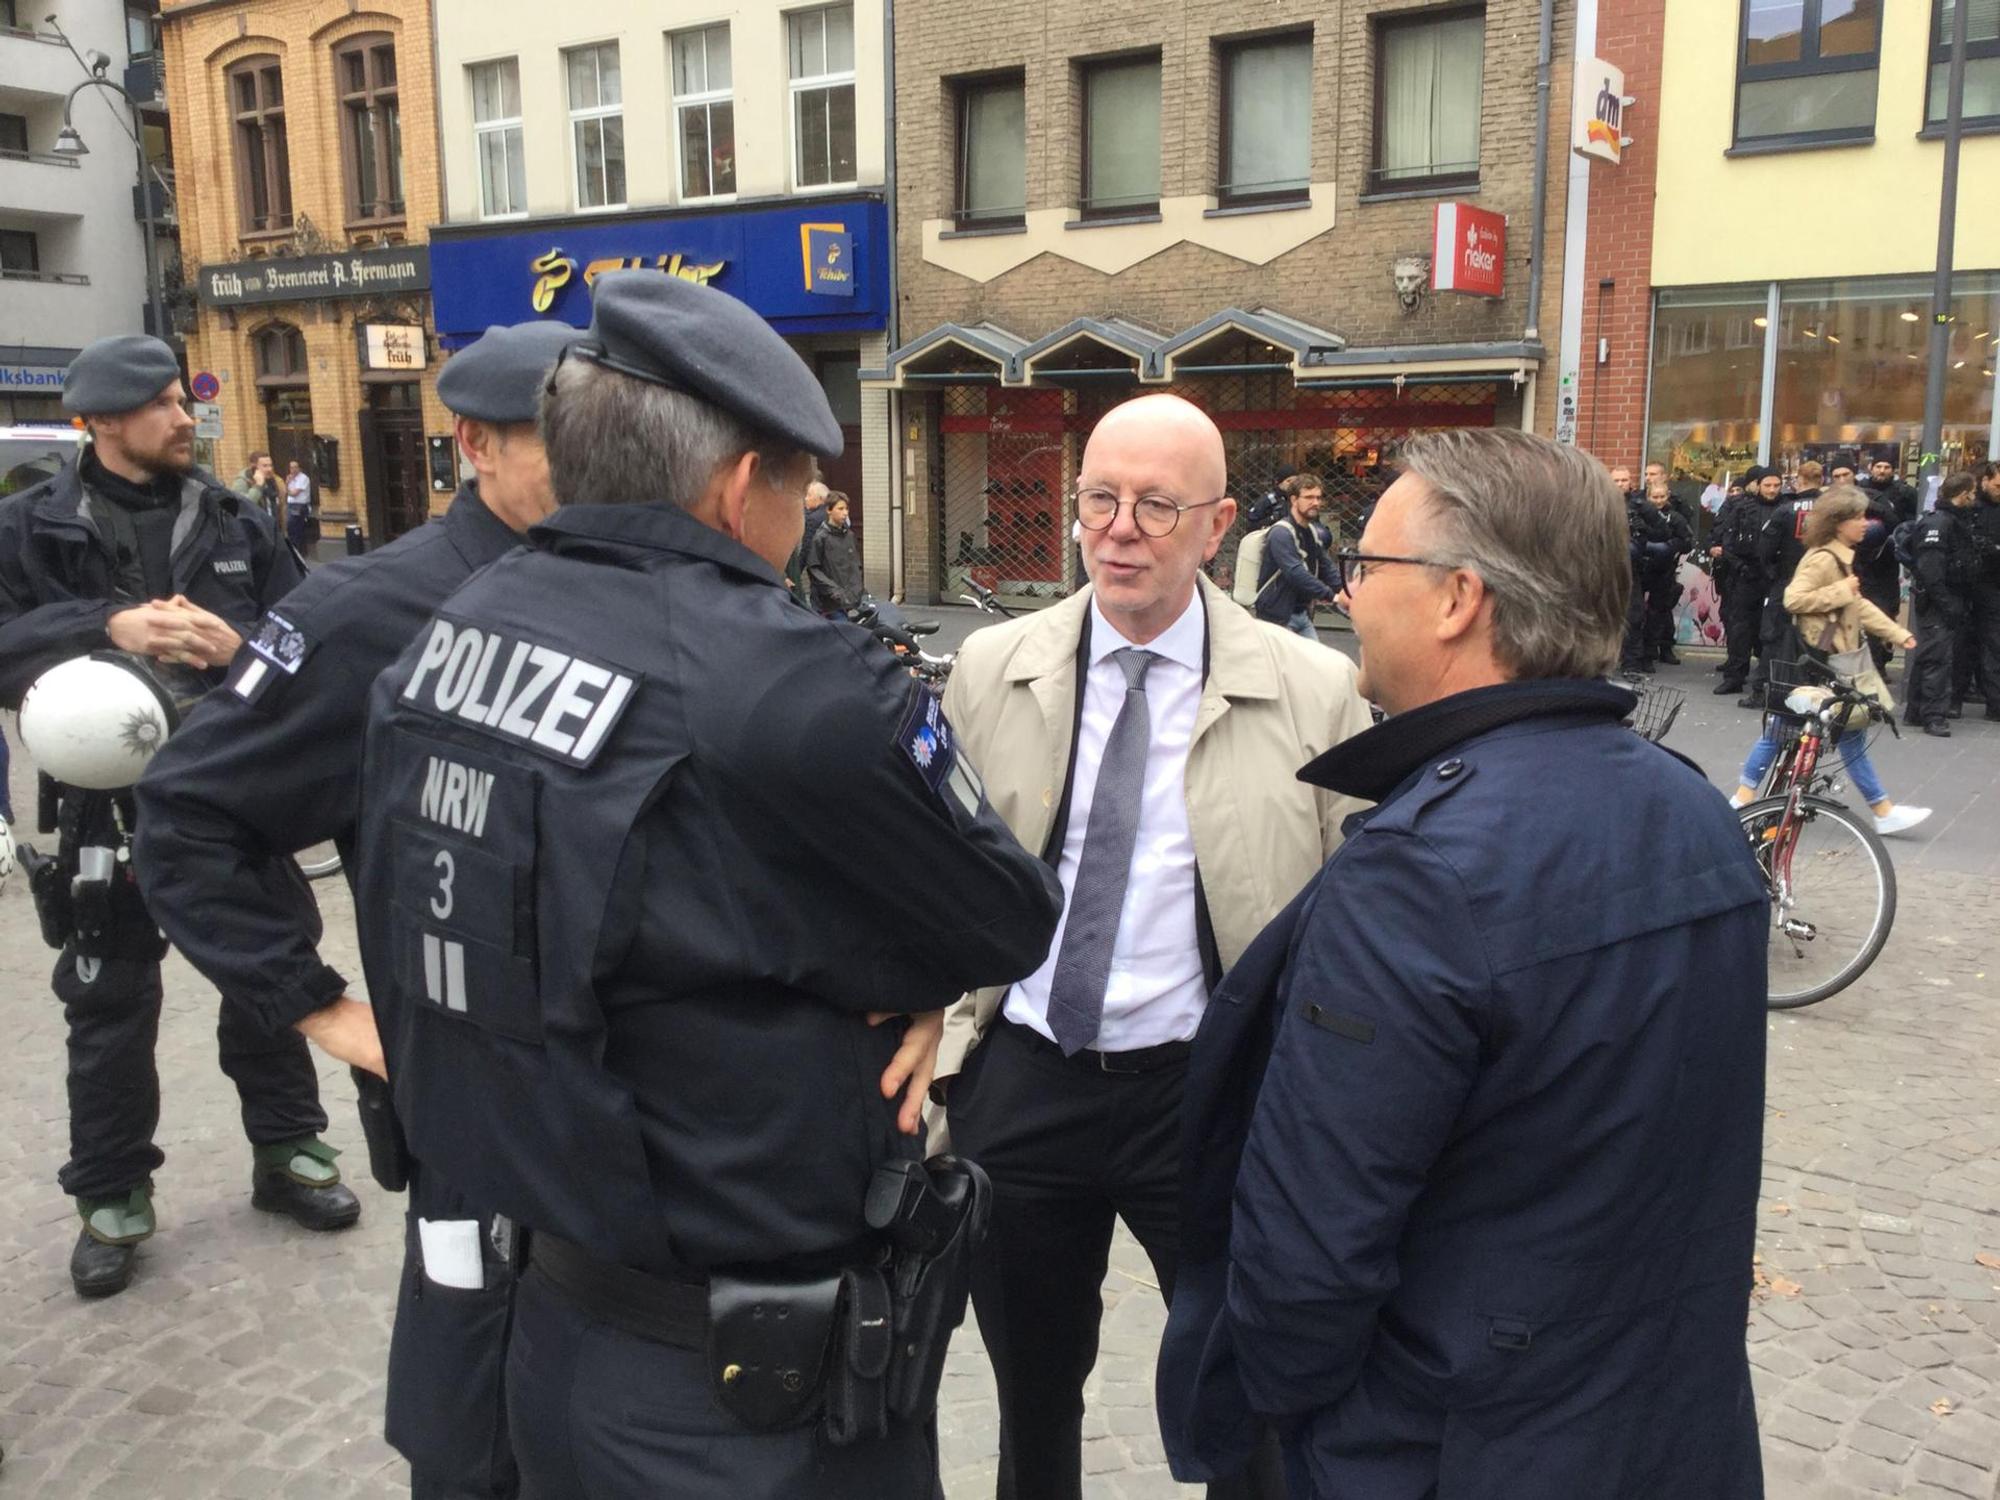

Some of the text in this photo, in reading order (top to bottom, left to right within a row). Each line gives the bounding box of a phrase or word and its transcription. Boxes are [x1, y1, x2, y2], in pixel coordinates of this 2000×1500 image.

[1596, 78, 1620, 128] dm
[266, 264, 329, 292] Brennerei
[1465, 244, 1496, 271] rieker
[213, 560, 247, 573] POLIZEI
[403, 619, 633, 760] POLIZEI
[420, 756, 494, 838] NRW
[430, 850, 455, 920] 3
